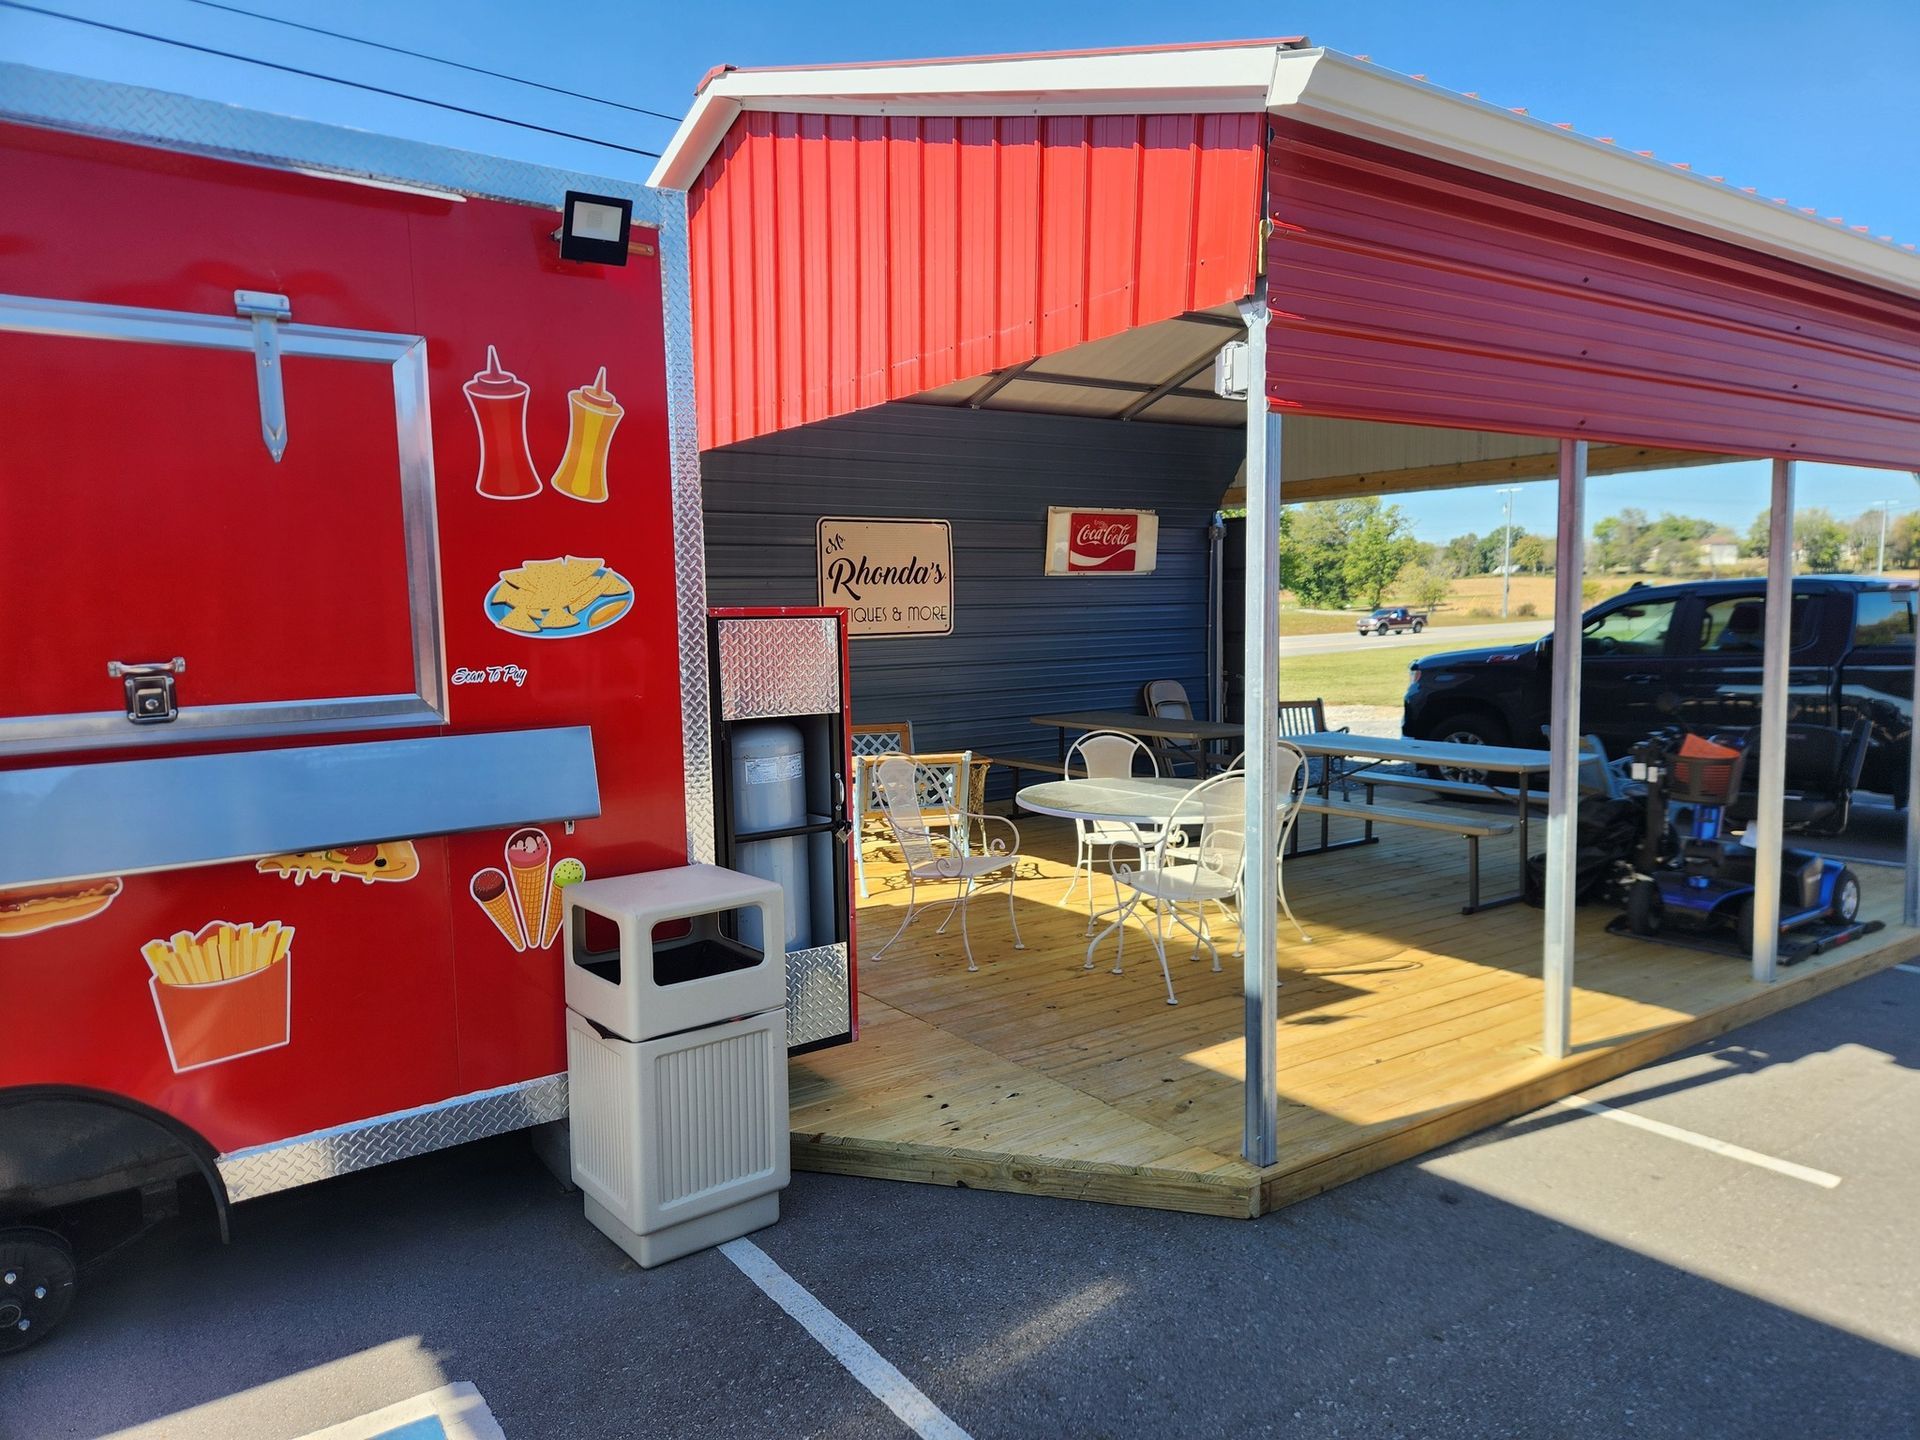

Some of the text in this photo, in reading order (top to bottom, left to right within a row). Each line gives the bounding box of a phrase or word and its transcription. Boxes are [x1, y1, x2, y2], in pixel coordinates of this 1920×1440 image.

[1077, 524, 1132, 545] Coca-Cola
[828, 555, 945, 601] Rhonda's
[847, 605, 947, 622] IQUES & MORE
[451, 664, 527, 687] Scan To Pay
